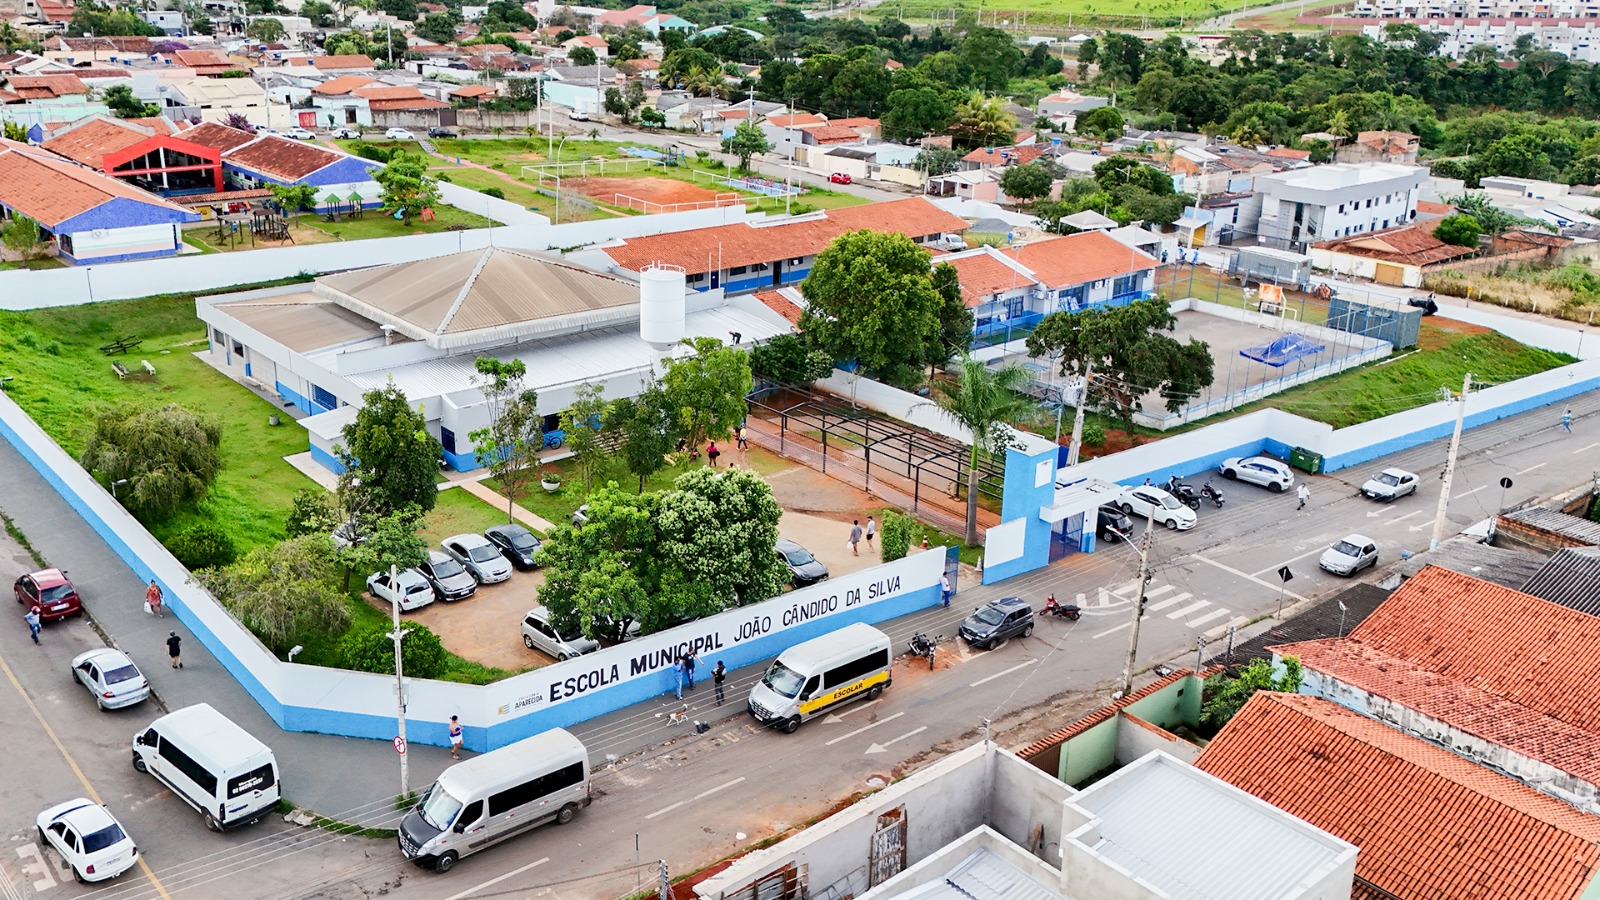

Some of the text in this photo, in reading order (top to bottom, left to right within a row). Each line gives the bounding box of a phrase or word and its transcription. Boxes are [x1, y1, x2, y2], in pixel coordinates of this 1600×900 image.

[549, 664, 619, 702] ESCOLA
[734, 616, 772, 642] JOÃO
[782, 595, 838, 626] CÂNDIDO
[846, 588, 861, 607] DA
[868, 576, 901, 599] SILVA
[833, 682, 864, 699] ESCOLAR
[514, 694, 543, 709] APARECIDA
